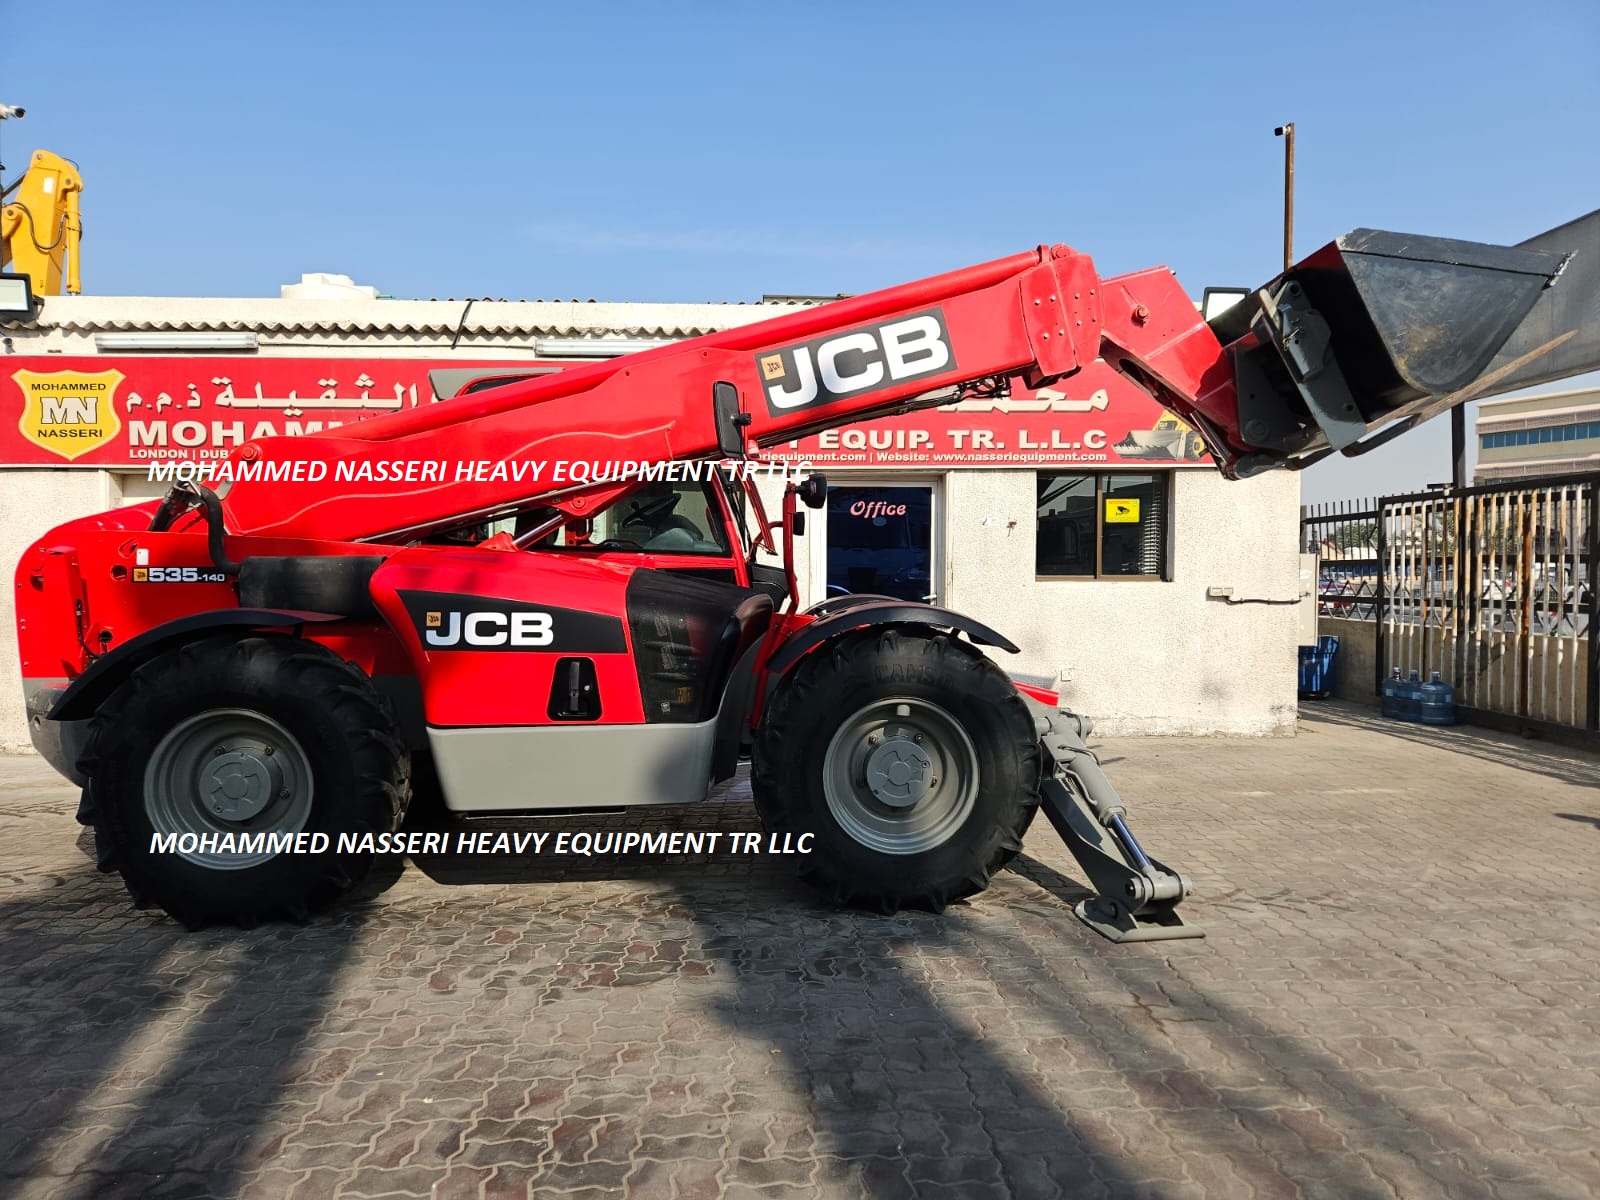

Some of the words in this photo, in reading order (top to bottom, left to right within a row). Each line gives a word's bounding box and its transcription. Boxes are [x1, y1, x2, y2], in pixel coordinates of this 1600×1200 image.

[768, 315, 949, 409] JCB
[31, 383, 107, 391] MOHAMMED
[211, 373, 417, 417] الثقيلة
[126, 383, 201, 413] ذ.م.م
[40, 397, 98, 424] MN
[37, 429, 103, 438] NASSERI
[819, 429, 934, 450] EQUIP.
[947, 430, 1005, 449] TR.
[1019, 430, 1107, 449] L.L.C
[129, 449, 187, 459] LONDON
[200, 449, 236, 459] DUB
[877, 452, 929, 462] Website:
[933, 452, 1107, 463] www.nasseriequipment.com
[849, 501, 907, 519] Office
[149, 567, 225, 582] 535-140
[426, 612, 554, 645] JCB
